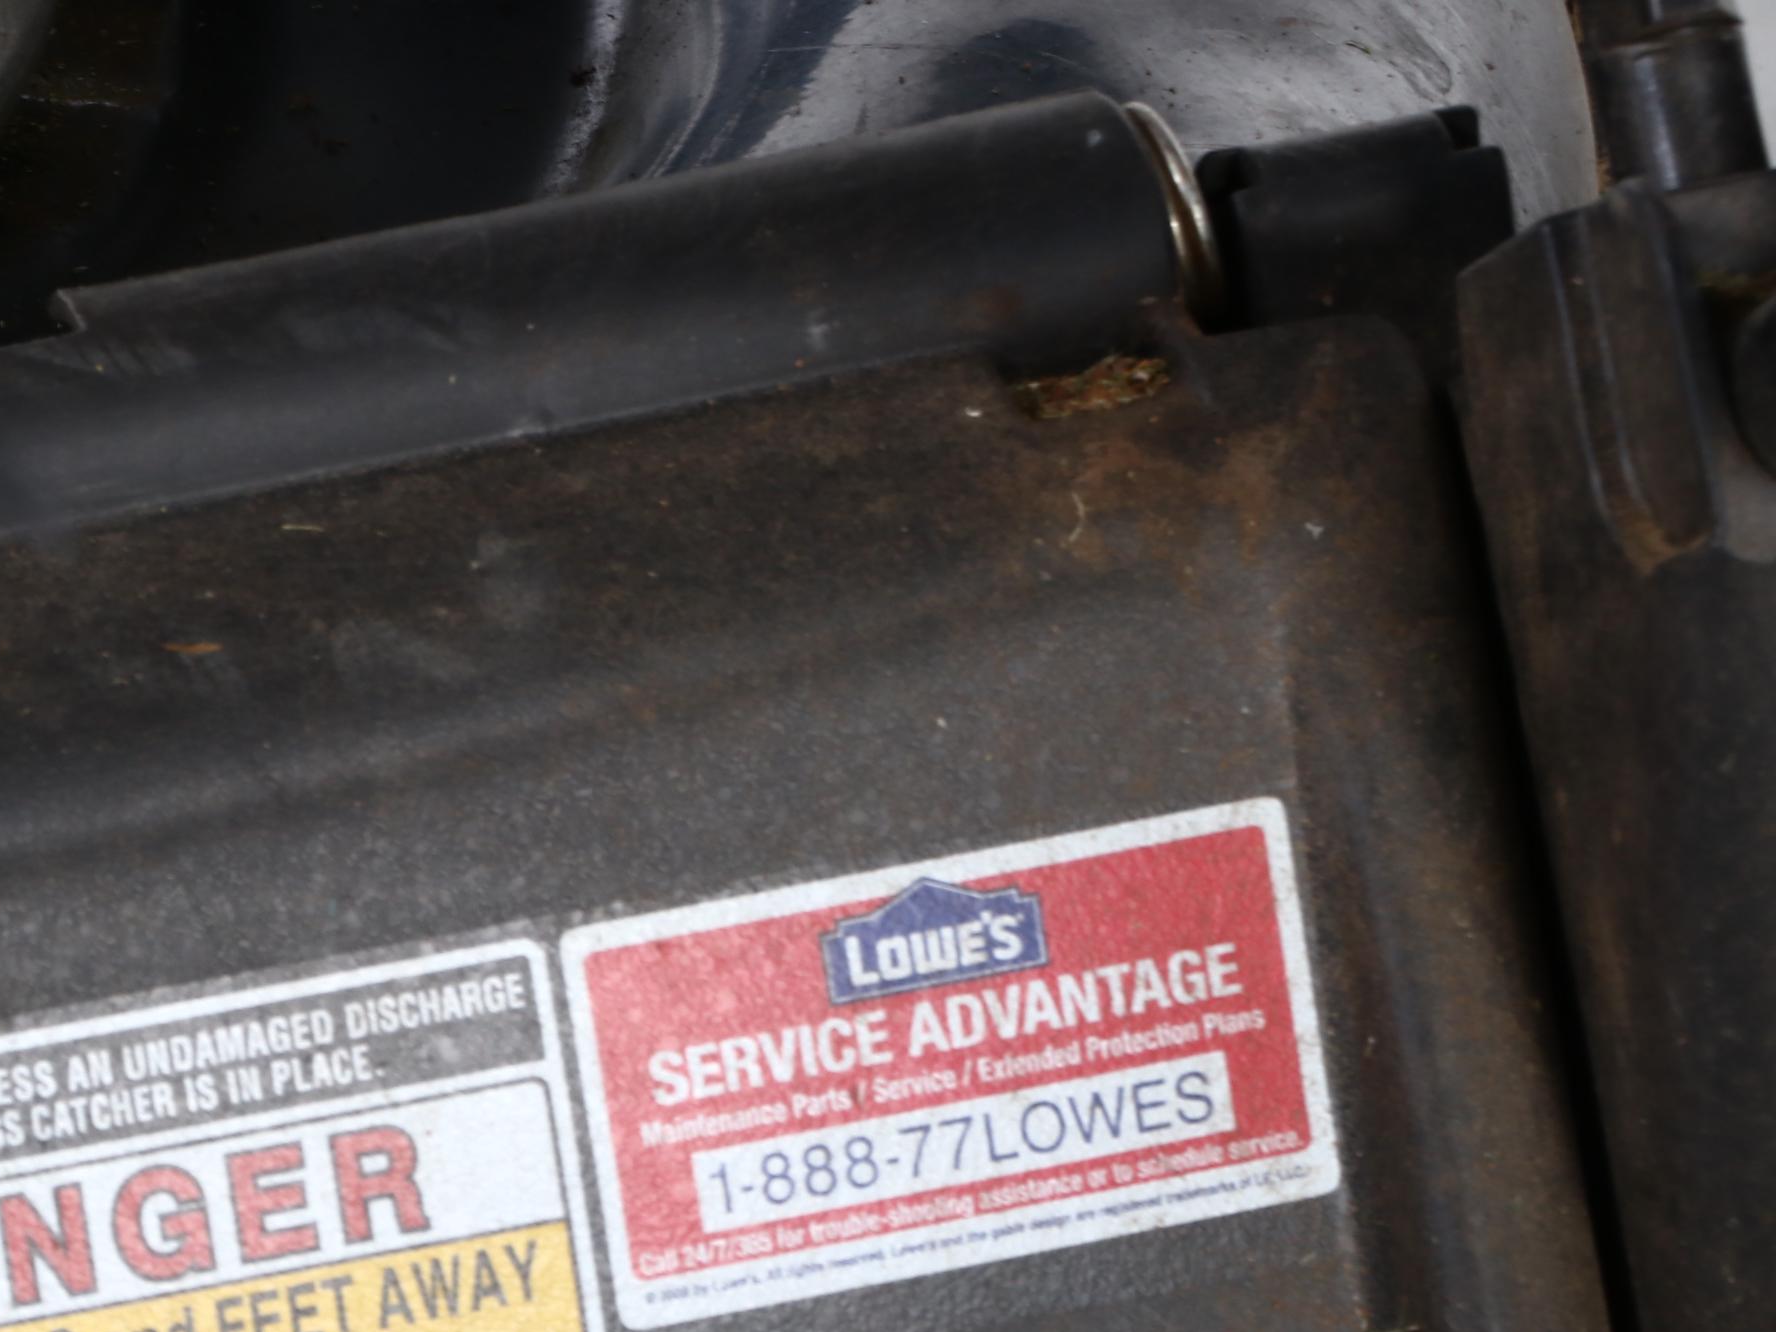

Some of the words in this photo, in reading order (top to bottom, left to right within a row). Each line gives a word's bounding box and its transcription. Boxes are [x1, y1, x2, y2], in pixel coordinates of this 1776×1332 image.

[64, 1047, 114, 1092] AN
[120, 1007, 336, 1082] UNDAMAGED
[344, 972, 527, 1041] DISCHARGE
[645, 1008, 894, 1107] SERVICE
[901, 942, 1244, 1059] ADVANTAGE
[790, 1084, 852, 1121] Parts
[871, 1064, 958, 1106] Service
[975, 1039, 1081, 1082] Extended
[1084, 1017, 1199, 1062] Protection
[1202, 1004, 1266, 1040] Plans
[29, 1082, 176, 1142] CATCHER
[182, 1073, 218, 1113] IS
[225, 1065, 263, 1105] IN
[269, 1043, 385, 1097] PLACE.
[707, 1068, 1215, 1216] 1-888-77LOWES
[371, 1240, 546, 1331] AWAY
